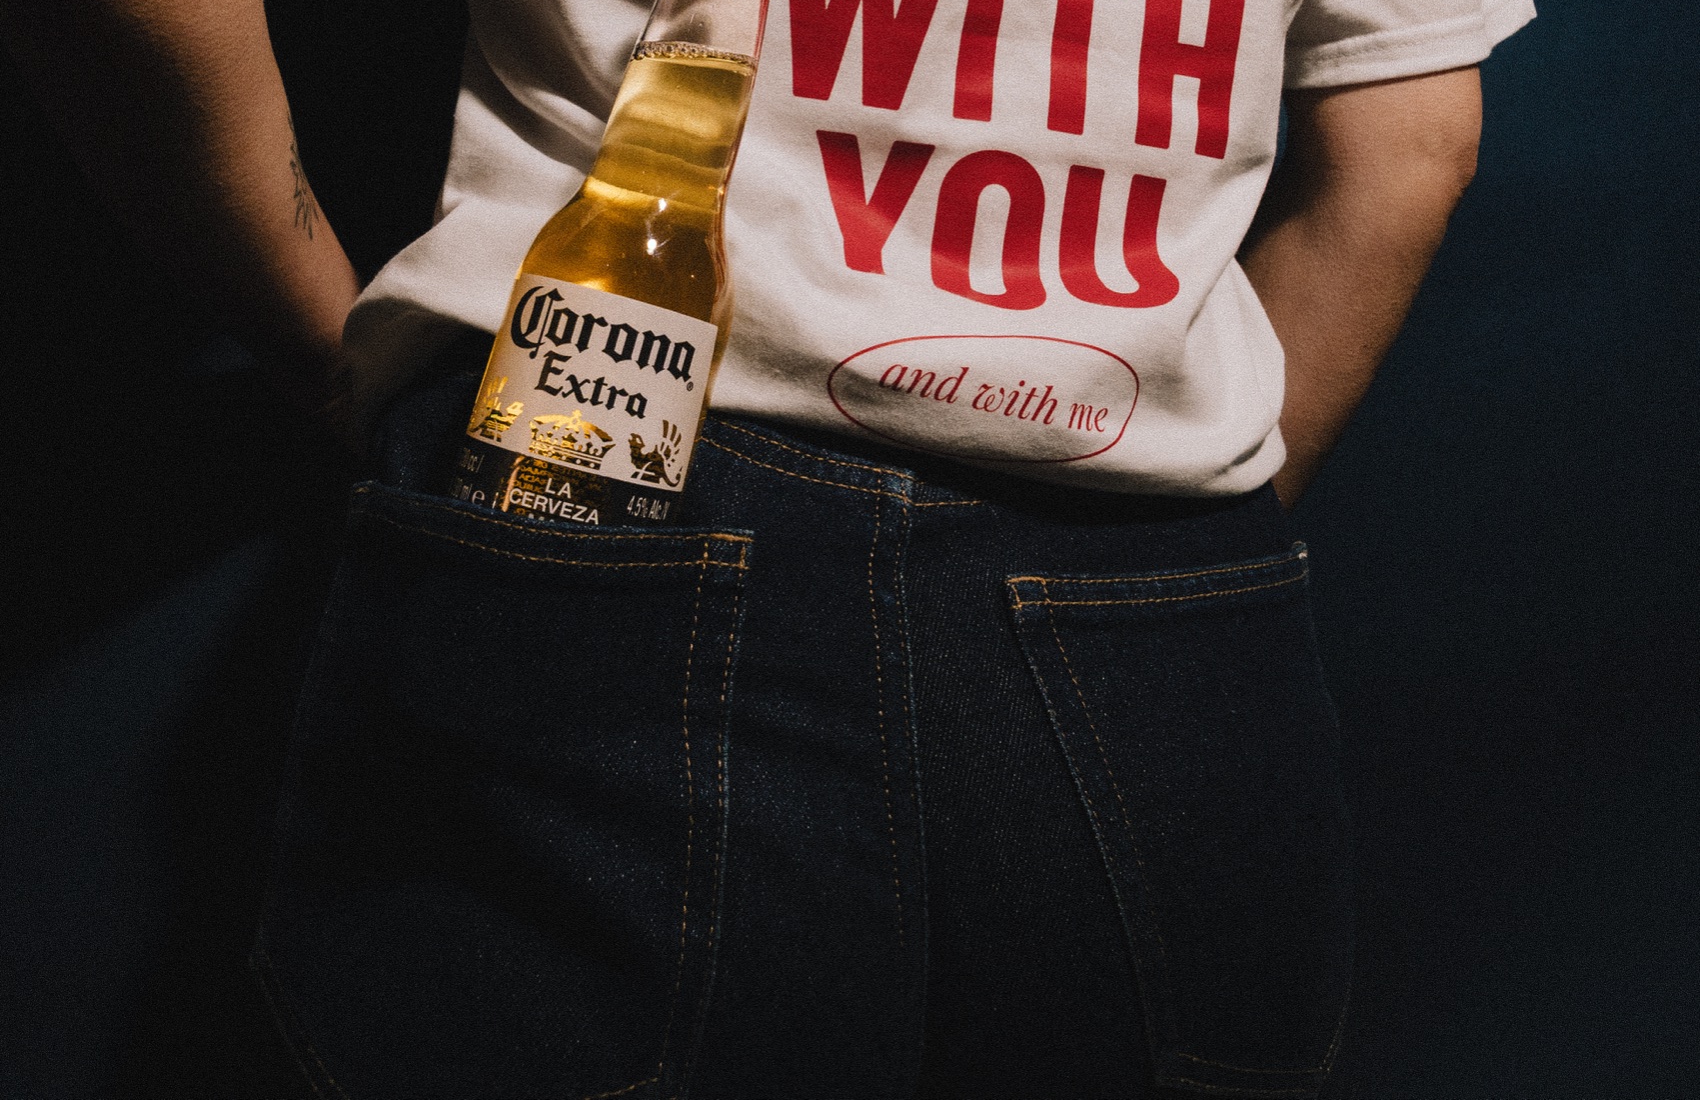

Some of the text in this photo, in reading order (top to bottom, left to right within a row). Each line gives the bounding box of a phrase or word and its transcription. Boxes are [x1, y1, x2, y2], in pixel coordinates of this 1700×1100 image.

[816, 130, 1181, 311] YOU
[509, 285, 697, 383] Corona
[534, 350, 649, 420] Extra
[878, 363, 1109, 433] and with me
[508, 487, 600, 526] CERVEZA
[544, 477, 573, 499] LA
[626, 494, 649, 519] 4.5%
